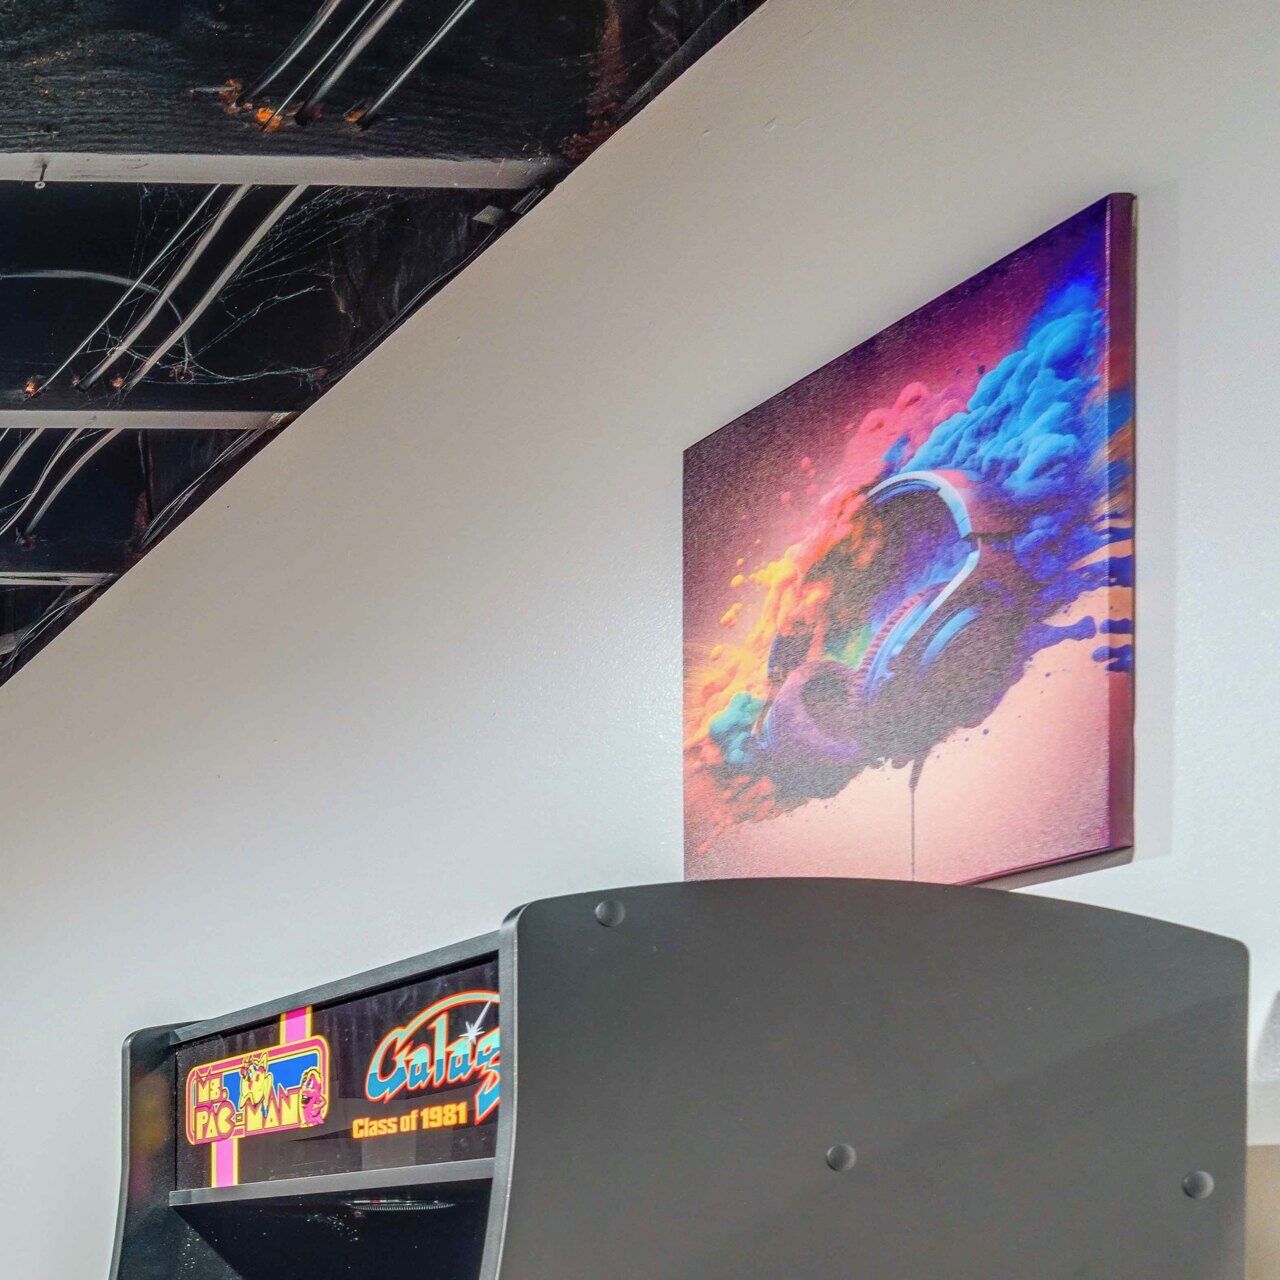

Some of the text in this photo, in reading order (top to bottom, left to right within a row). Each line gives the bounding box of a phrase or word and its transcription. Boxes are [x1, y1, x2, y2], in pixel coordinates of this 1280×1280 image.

[352, 1102, 467, 1139] Class of 1981
